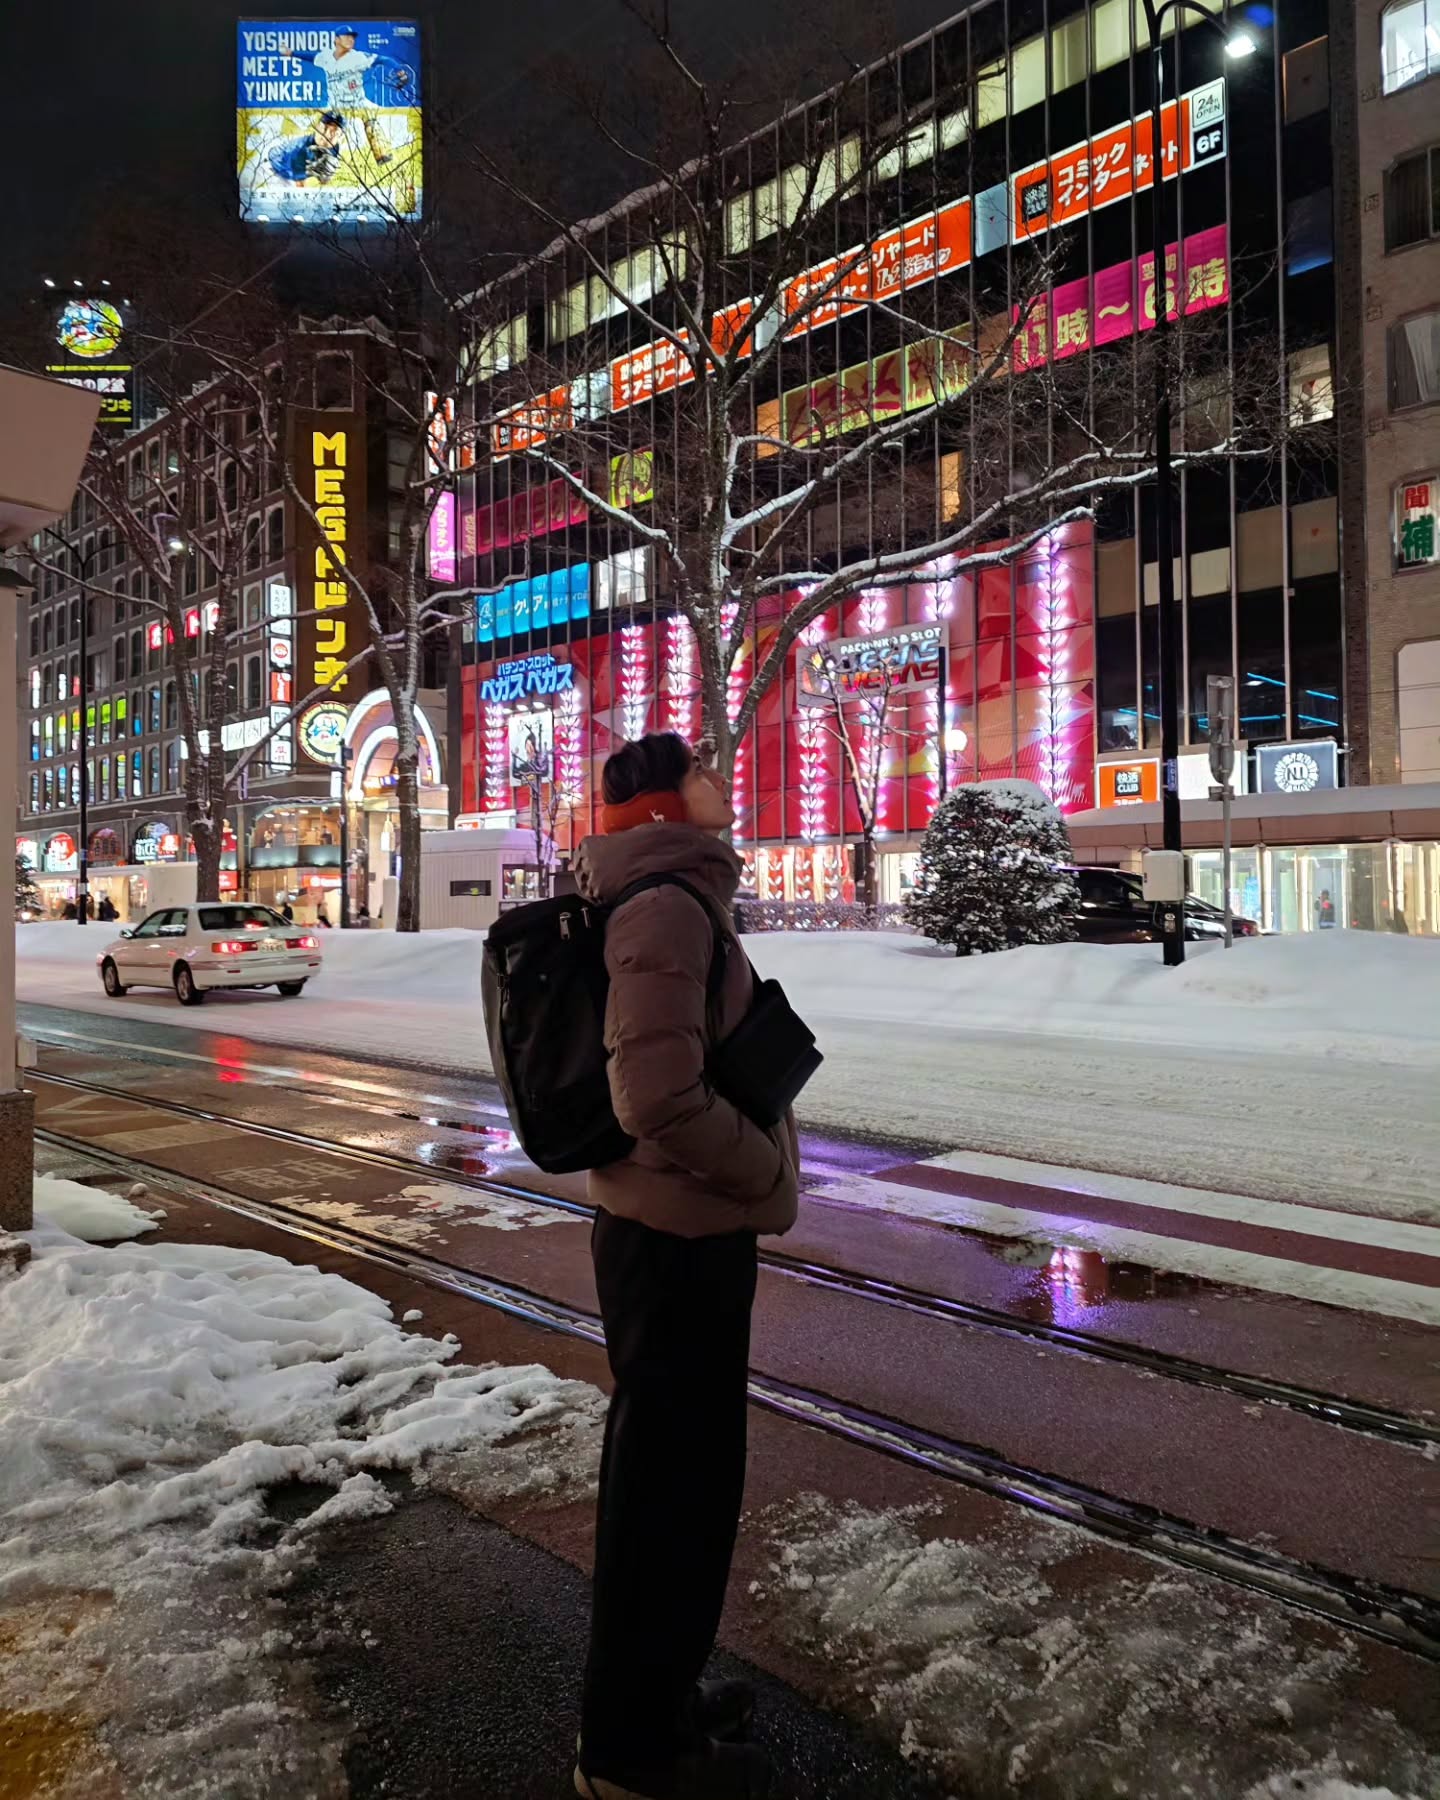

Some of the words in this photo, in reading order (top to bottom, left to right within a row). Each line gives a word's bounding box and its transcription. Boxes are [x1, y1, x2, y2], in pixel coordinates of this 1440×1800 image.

[242, 57, 303, 77] MEETS
[243, 81, 321, 101] YUNKER!
[1196, 104, 1221, 119] OPEN
[1196, 130, 1221, 154] 6F
[1058, 142, 1127, 187] コミック
[312, 431, 349, 692] MEGAドンキ
[911, 627, 942, 641] SLOT
[1116, 783, 1139, 793] CLUB
